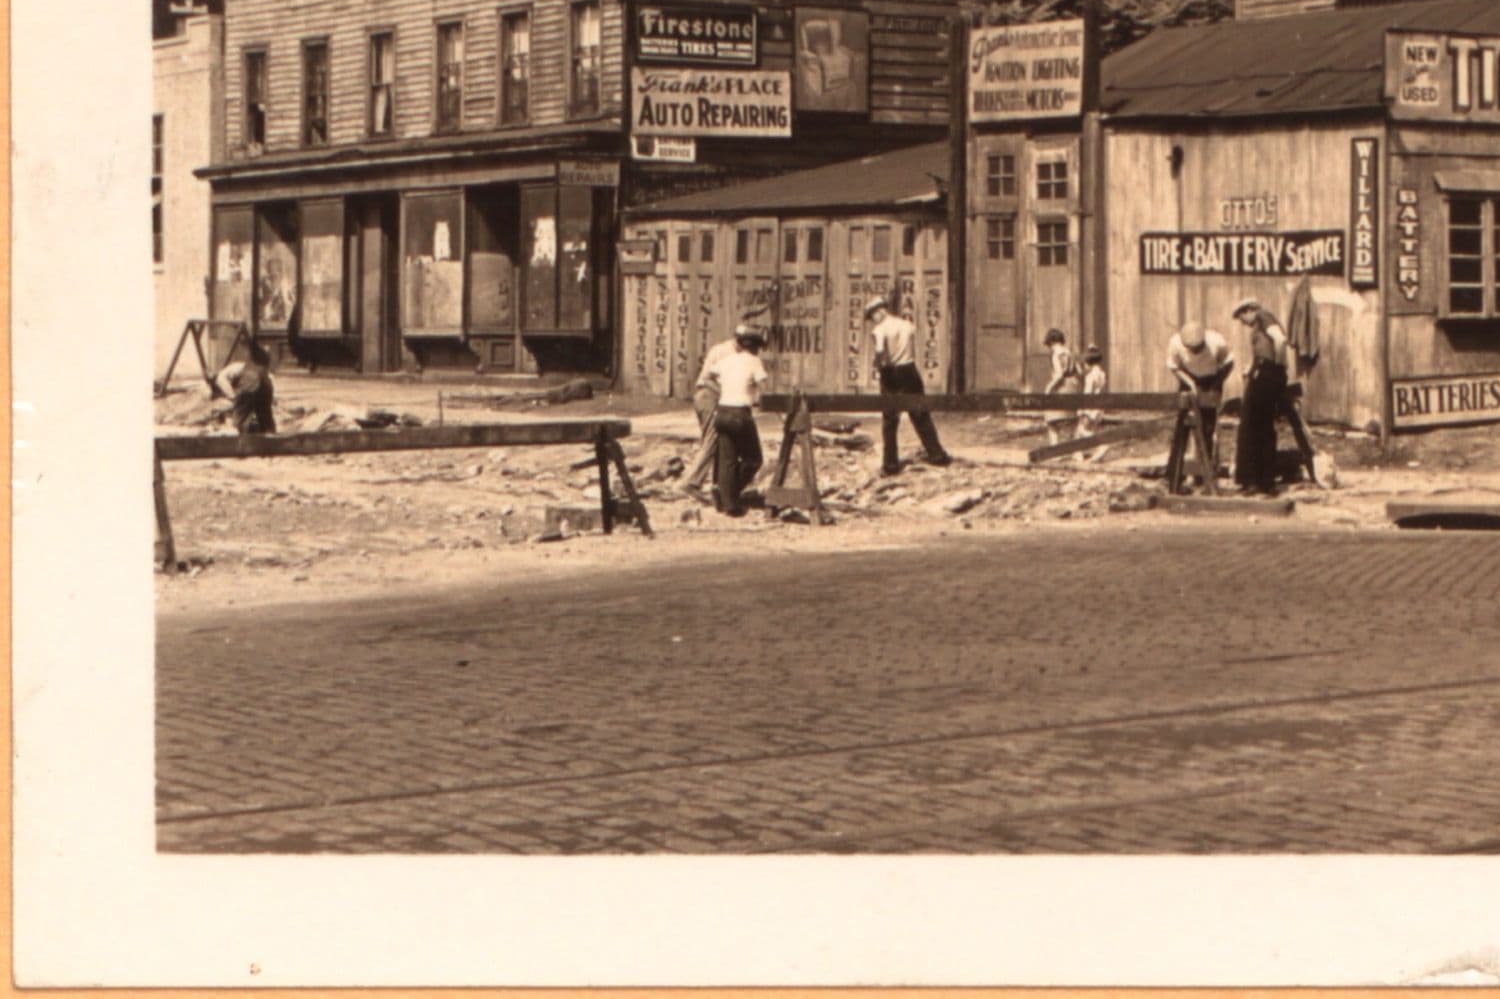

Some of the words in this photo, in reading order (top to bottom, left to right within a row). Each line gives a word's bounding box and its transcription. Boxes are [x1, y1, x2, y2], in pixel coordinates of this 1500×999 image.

[639, 9, 753, 38] Firestone
[680, 41, 715, 56] TIRES
[1405, 45, 1437, 62] NEW
[726, 78, 783, 95] PLACE
[1403, 86, 1437, 103] USED
[638, 95, 694, 127] AUTO
[698, 97, 787, 129] REPAIRING
[1355, 142, 1374, 267] WILLARD
[1143, 237, 1181, 271] TIRE
[1193, 236, 1284, 272] BATTERY
[1285, 236, 1341, 272] SERVICE
[1398, 189, 1419, 300] BATTERY
[677, 280, 689, 375] LIGHTING
